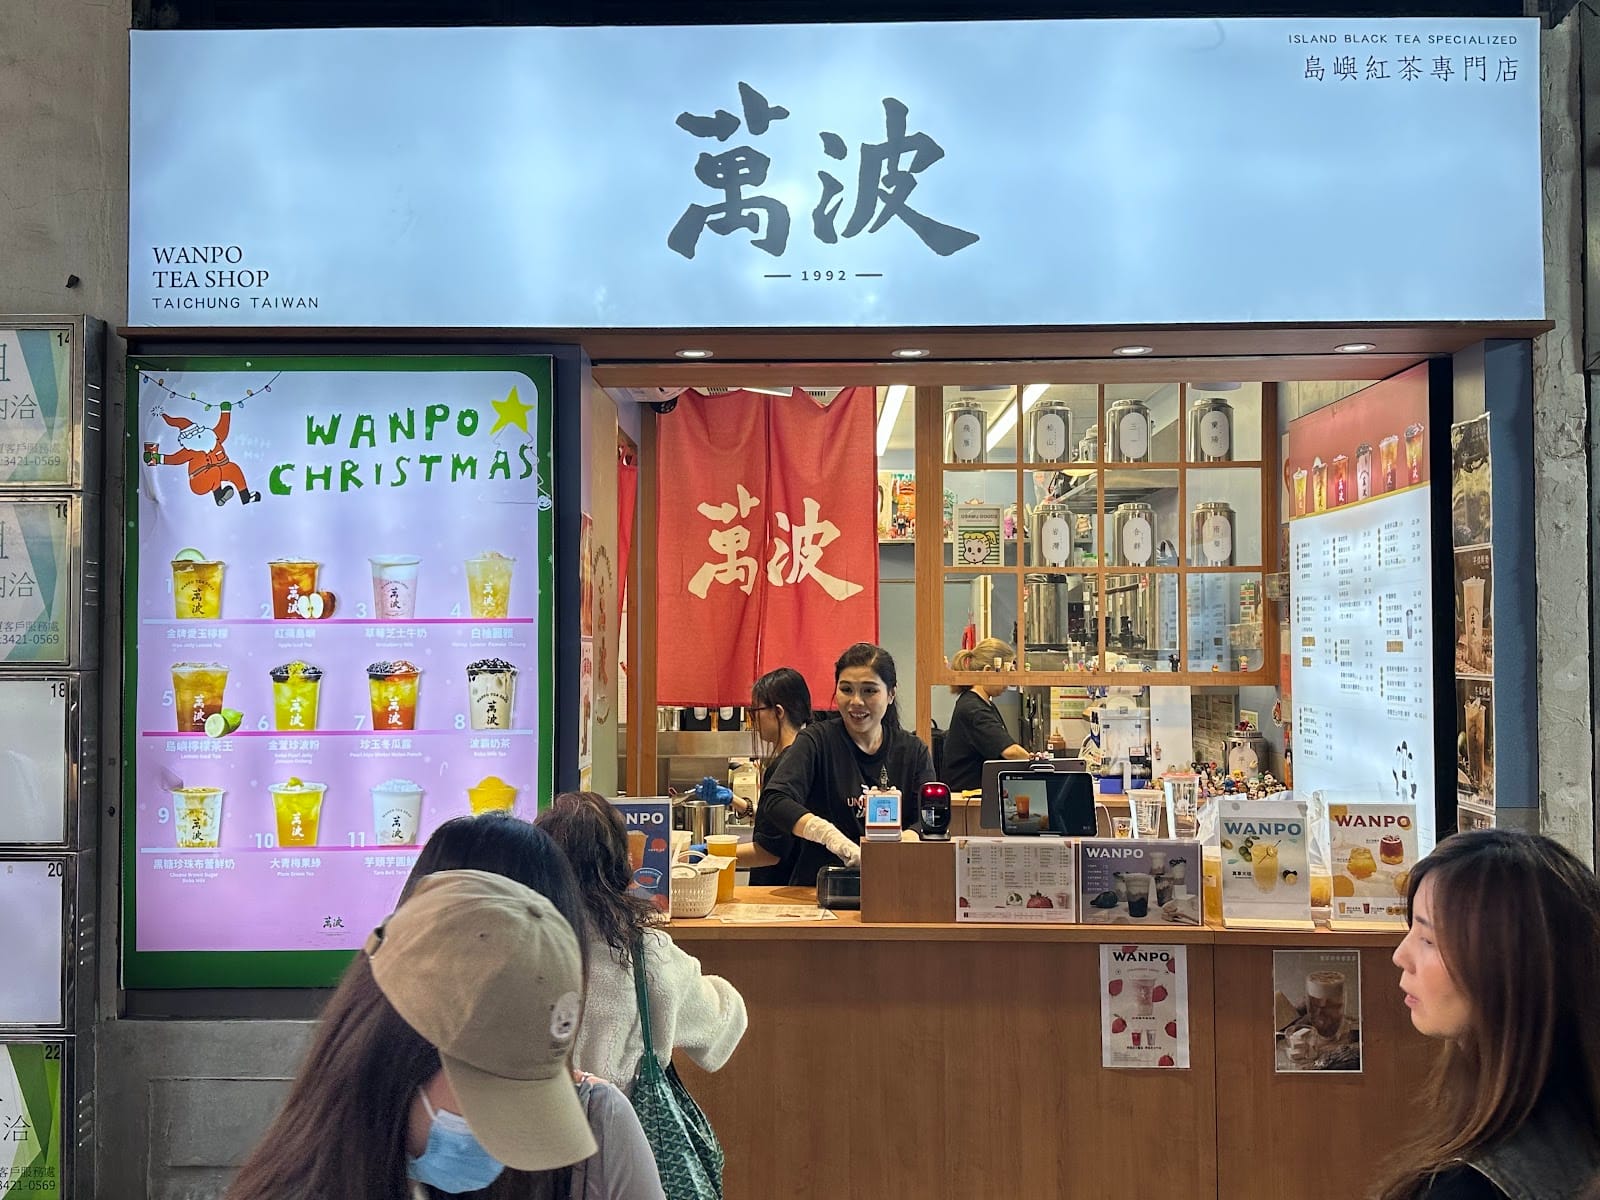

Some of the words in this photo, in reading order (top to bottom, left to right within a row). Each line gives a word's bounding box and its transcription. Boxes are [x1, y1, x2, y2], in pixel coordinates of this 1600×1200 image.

[1288, 34, 1338, 44] ISLAND
[1344, 34, 1388, 44] BLACK
[1395, 34, 1422, 44] TEA
[1428, 35, 1518, 45] SPECIALIZED
[1303, 55, 1520, 83] 島嶼紅茶專門店
[667, 81, 980, 260] 萬波
[152, 245, 243, 265] WANPO
[152, 270, 200, 289] TEA
[204, 269, 270, 288] SHOP
[801, 269, 847, 282] 1992
[152, 297, 241, 309] TAICHUNG
[250, 297, 319, 309] TAIWAN
[305, 403, 480, 449] WANPO
[268, 442, 534, 496] CHRISTMAS
[688, 484, 864, 601] 萬波
[260, 603, 272, 619] 2
[356, 603, 368, 618] 3
[450, 603, 463, 618] 4
[51, 682, 65, 698] 18
[162, 690, 173, 706] 5
[258, 715, 270, 731] 6
[354, 715, 366, 731] 7
[454, 714, 466, 730] 8
[158, 807, 170, 824] 9
[1334, 815, 1411, 828] WANPO
[1224, 822, 1302, 836] WANPO
[255, 832, 274, 849] 10
[348, 831, 365, 848] 11
[1086, 847, 1144, 859] WANPO
[48, 862, 63, 877] 20
[322, 915, 345, 929] 萬波
[1113, 951, 1170, 962] WANPO
[45, 1044, 61, 1060] 22
